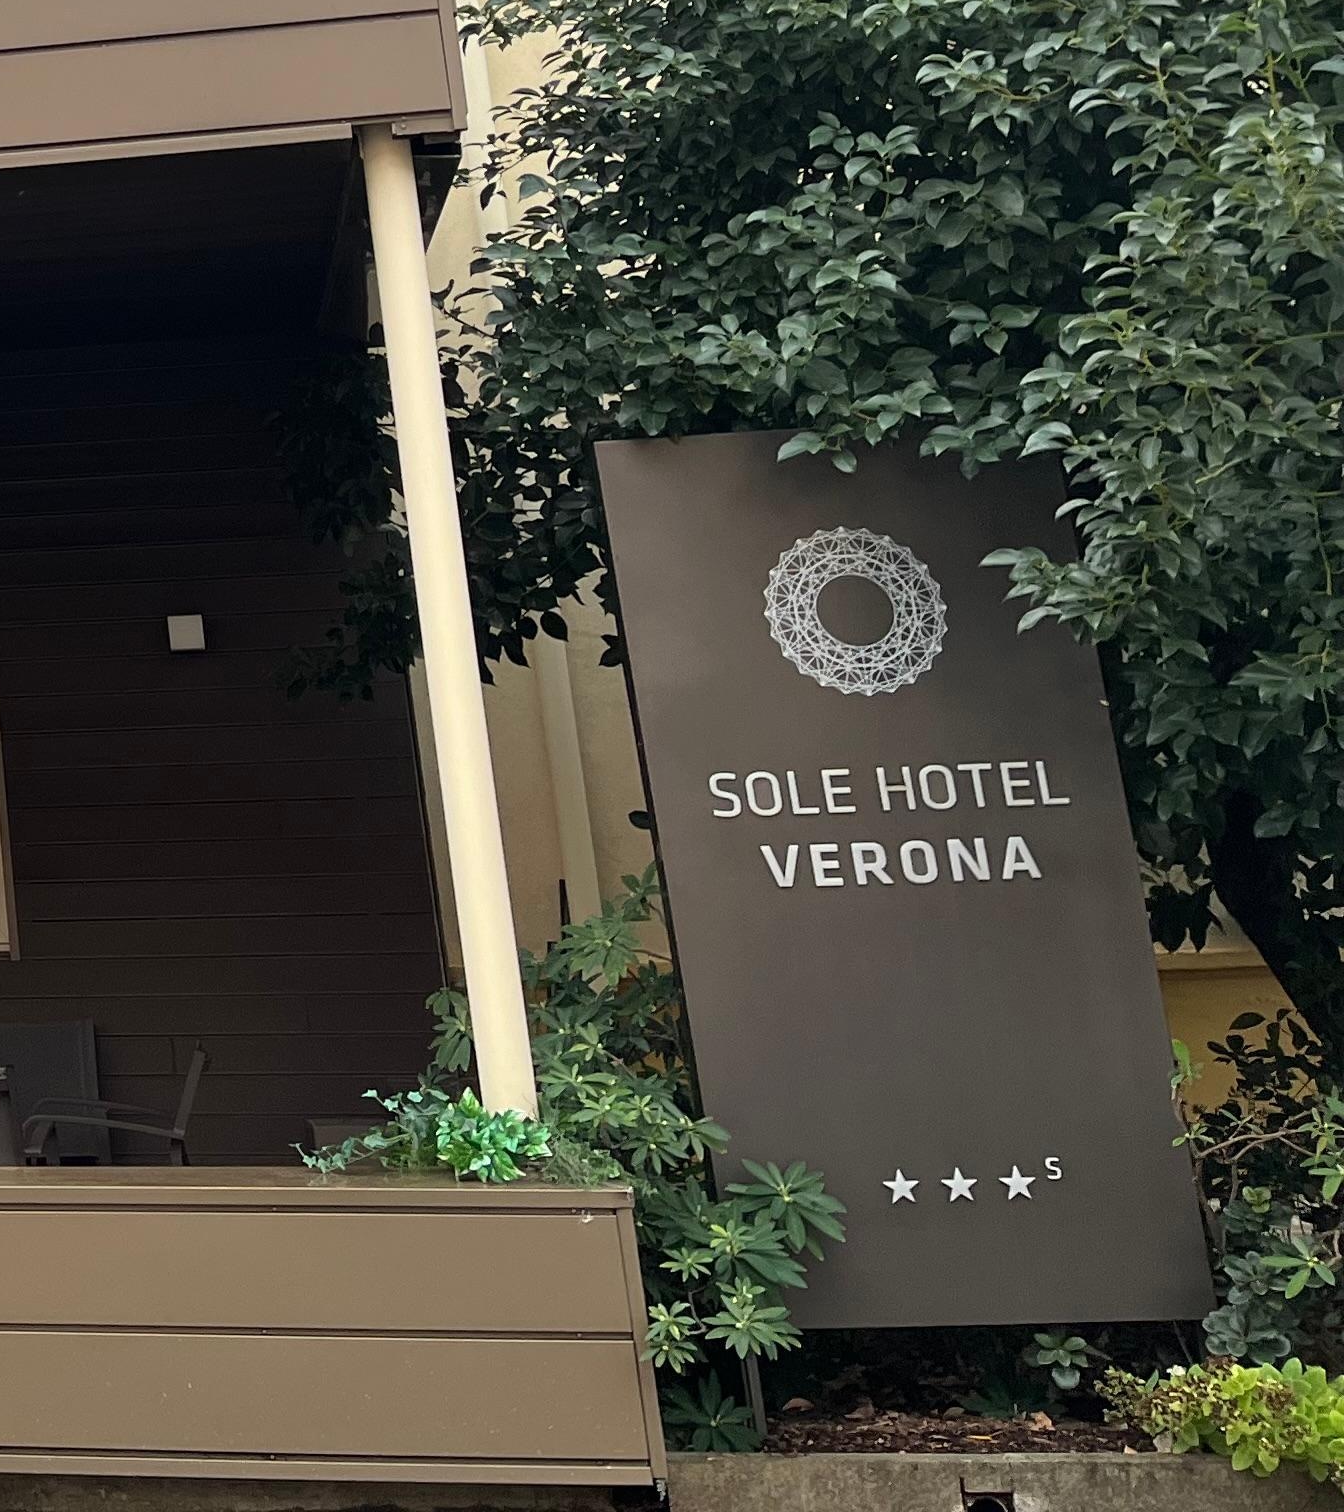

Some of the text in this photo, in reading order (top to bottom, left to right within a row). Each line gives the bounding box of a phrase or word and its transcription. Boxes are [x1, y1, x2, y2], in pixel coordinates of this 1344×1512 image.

[709, 760, 1071, 818] SOLE HOTEL
[759, 836, 1042, 888] VERONA
[1044, 1157, 1062, 1180] S
